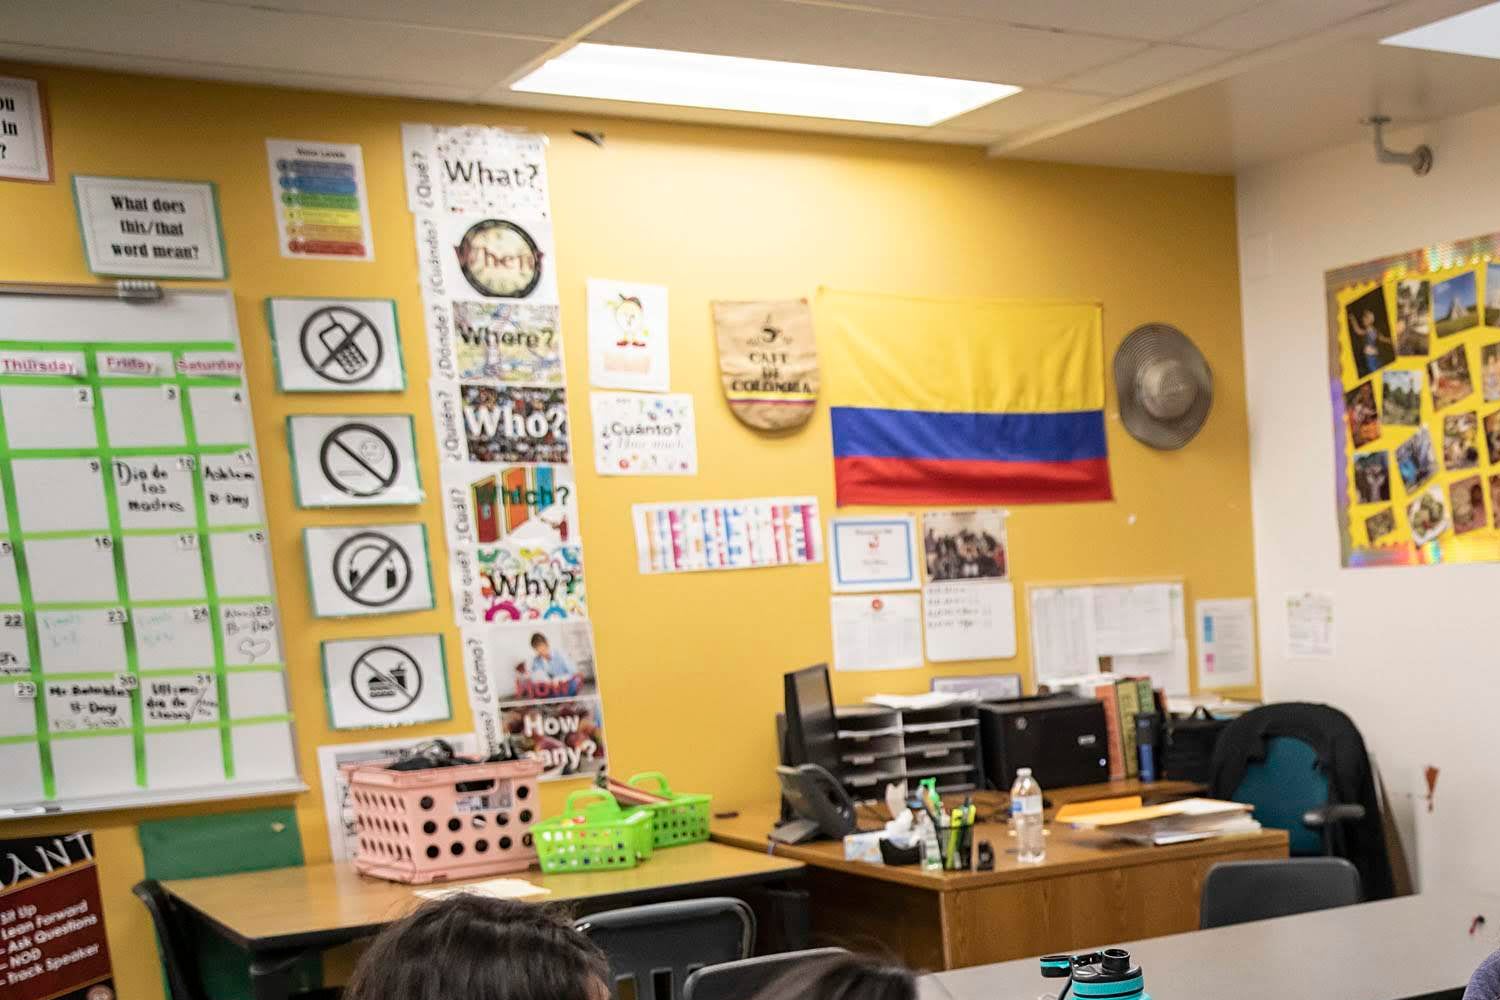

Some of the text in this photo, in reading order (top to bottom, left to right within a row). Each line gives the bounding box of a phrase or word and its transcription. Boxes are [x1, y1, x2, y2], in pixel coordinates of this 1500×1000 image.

[444, 159, 540, 189] What?
[111, 195, 187, 213] What does
[120, 218, 184, 238] this/that
[111, 242, 200, 261] word mean?
[458, 324, 555, 349] Where?
[79, 390, 88, 402] 2
[462, 403, 569, 440] Who?
[489, 571, 575, 602] Why?
[4, 615, 22, 627] 22
[108, 609, 125, 623] 23
[523, 713, 581, 738] How
[9, 947, 42, 968] NOD
